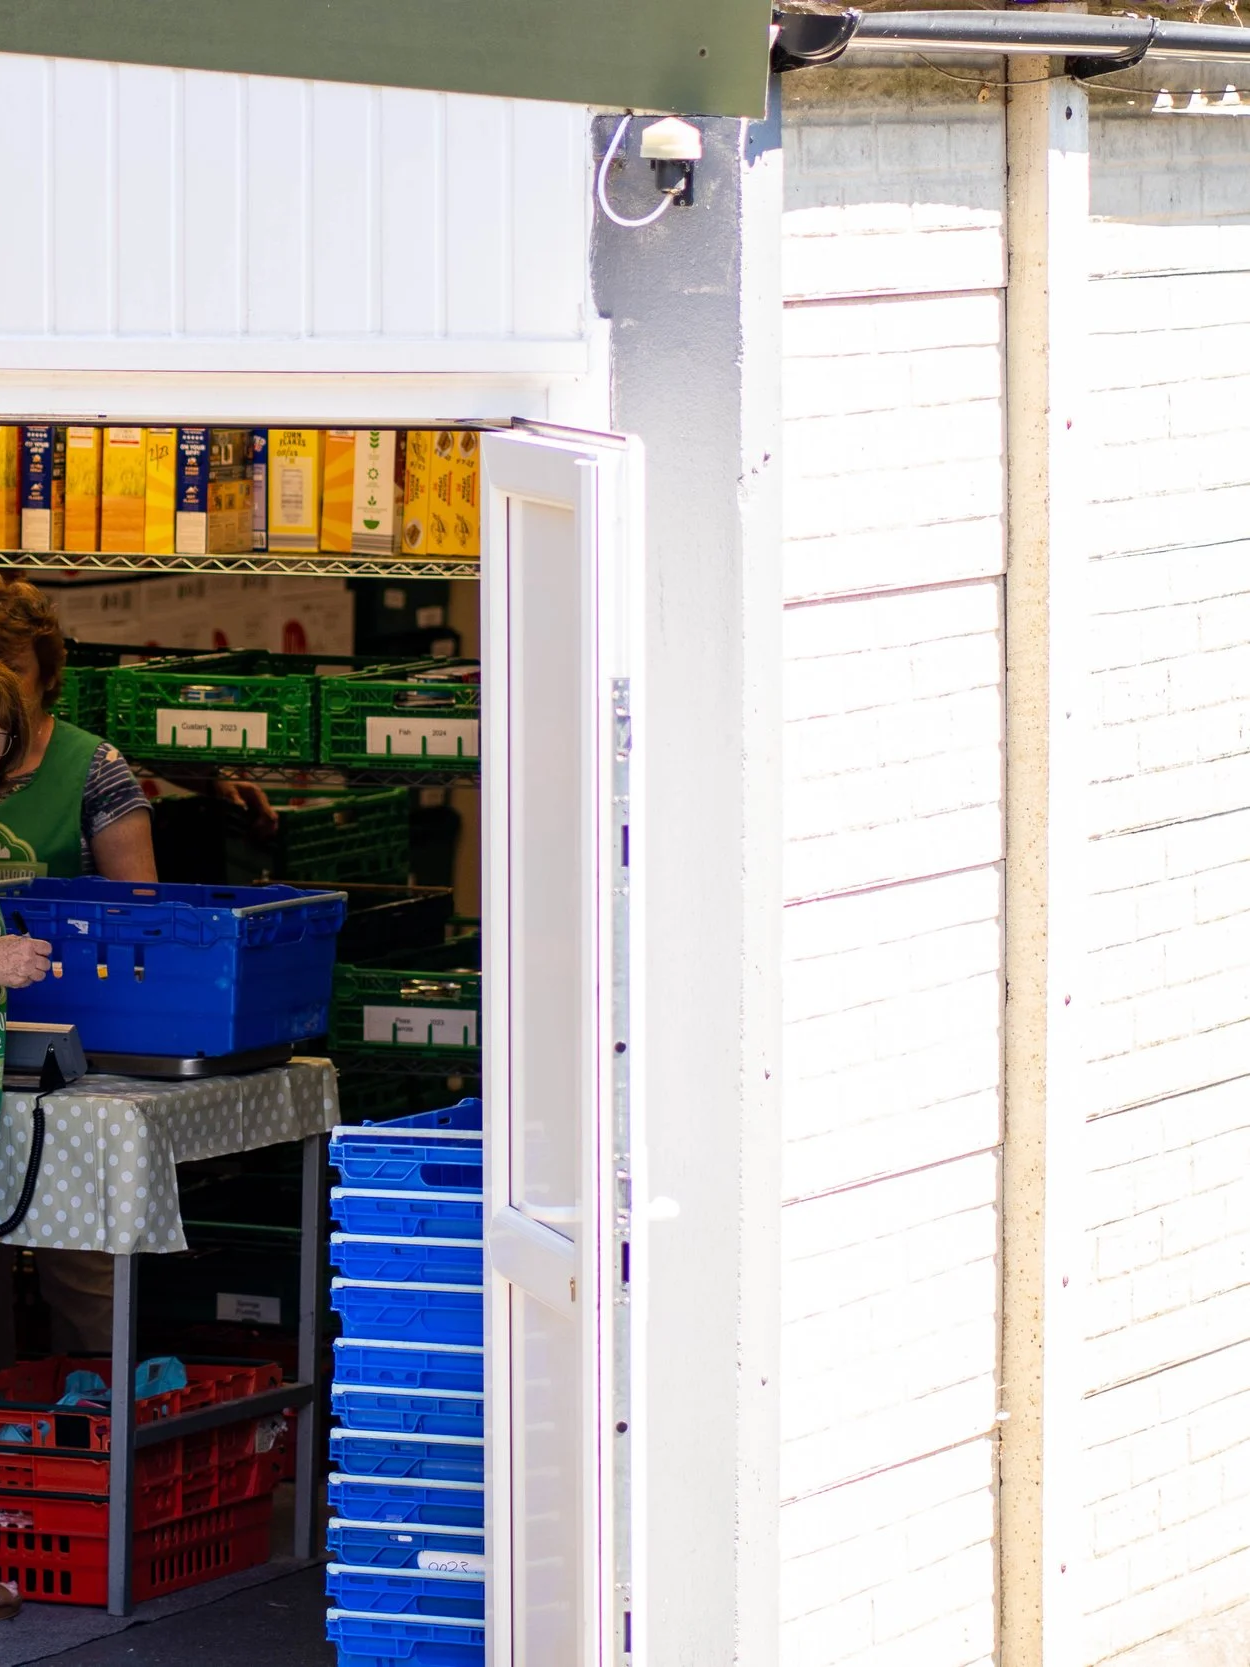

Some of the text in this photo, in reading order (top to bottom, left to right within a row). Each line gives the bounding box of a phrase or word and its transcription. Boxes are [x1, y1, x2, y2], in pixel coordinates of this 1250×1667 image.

[181, 722, 237, 732] Custard 2023
[398, 728, 412, 736] Fish
